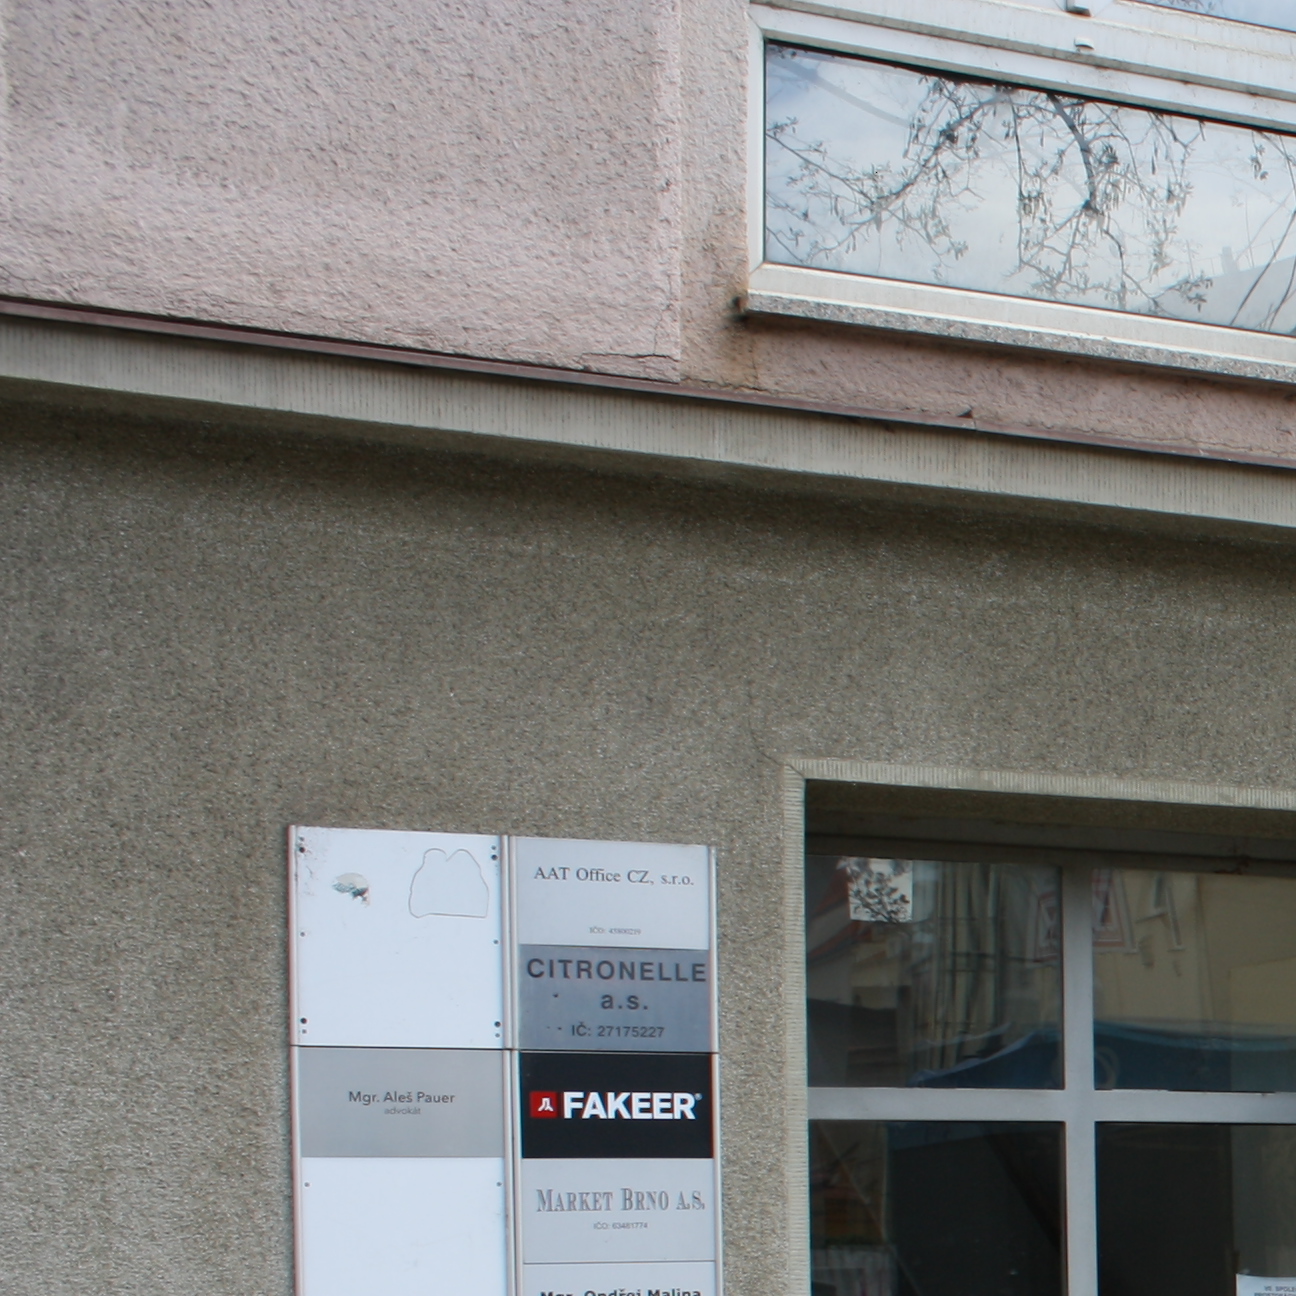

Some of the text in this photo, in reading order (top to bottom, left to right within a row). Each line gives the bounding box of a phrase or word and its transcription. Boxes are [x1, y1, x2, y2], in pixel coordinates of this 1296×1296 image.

[534, 867, 694, 885] AAT Office CZ, s.r.o.
[527, 958, 706, 982] CITRONELLE
[601, 994, 648, 1010] a.s.
[572, 1022, 665, 1038] IČ: 27175227
[349, 1091, 455, 1106] Mgr. Aleš Pauer
[563, 1091, 696, 1119] FAKEER
[536, 1189, 613, 1212] MARKET
[621, 1188, 669, 1211] BRNO
